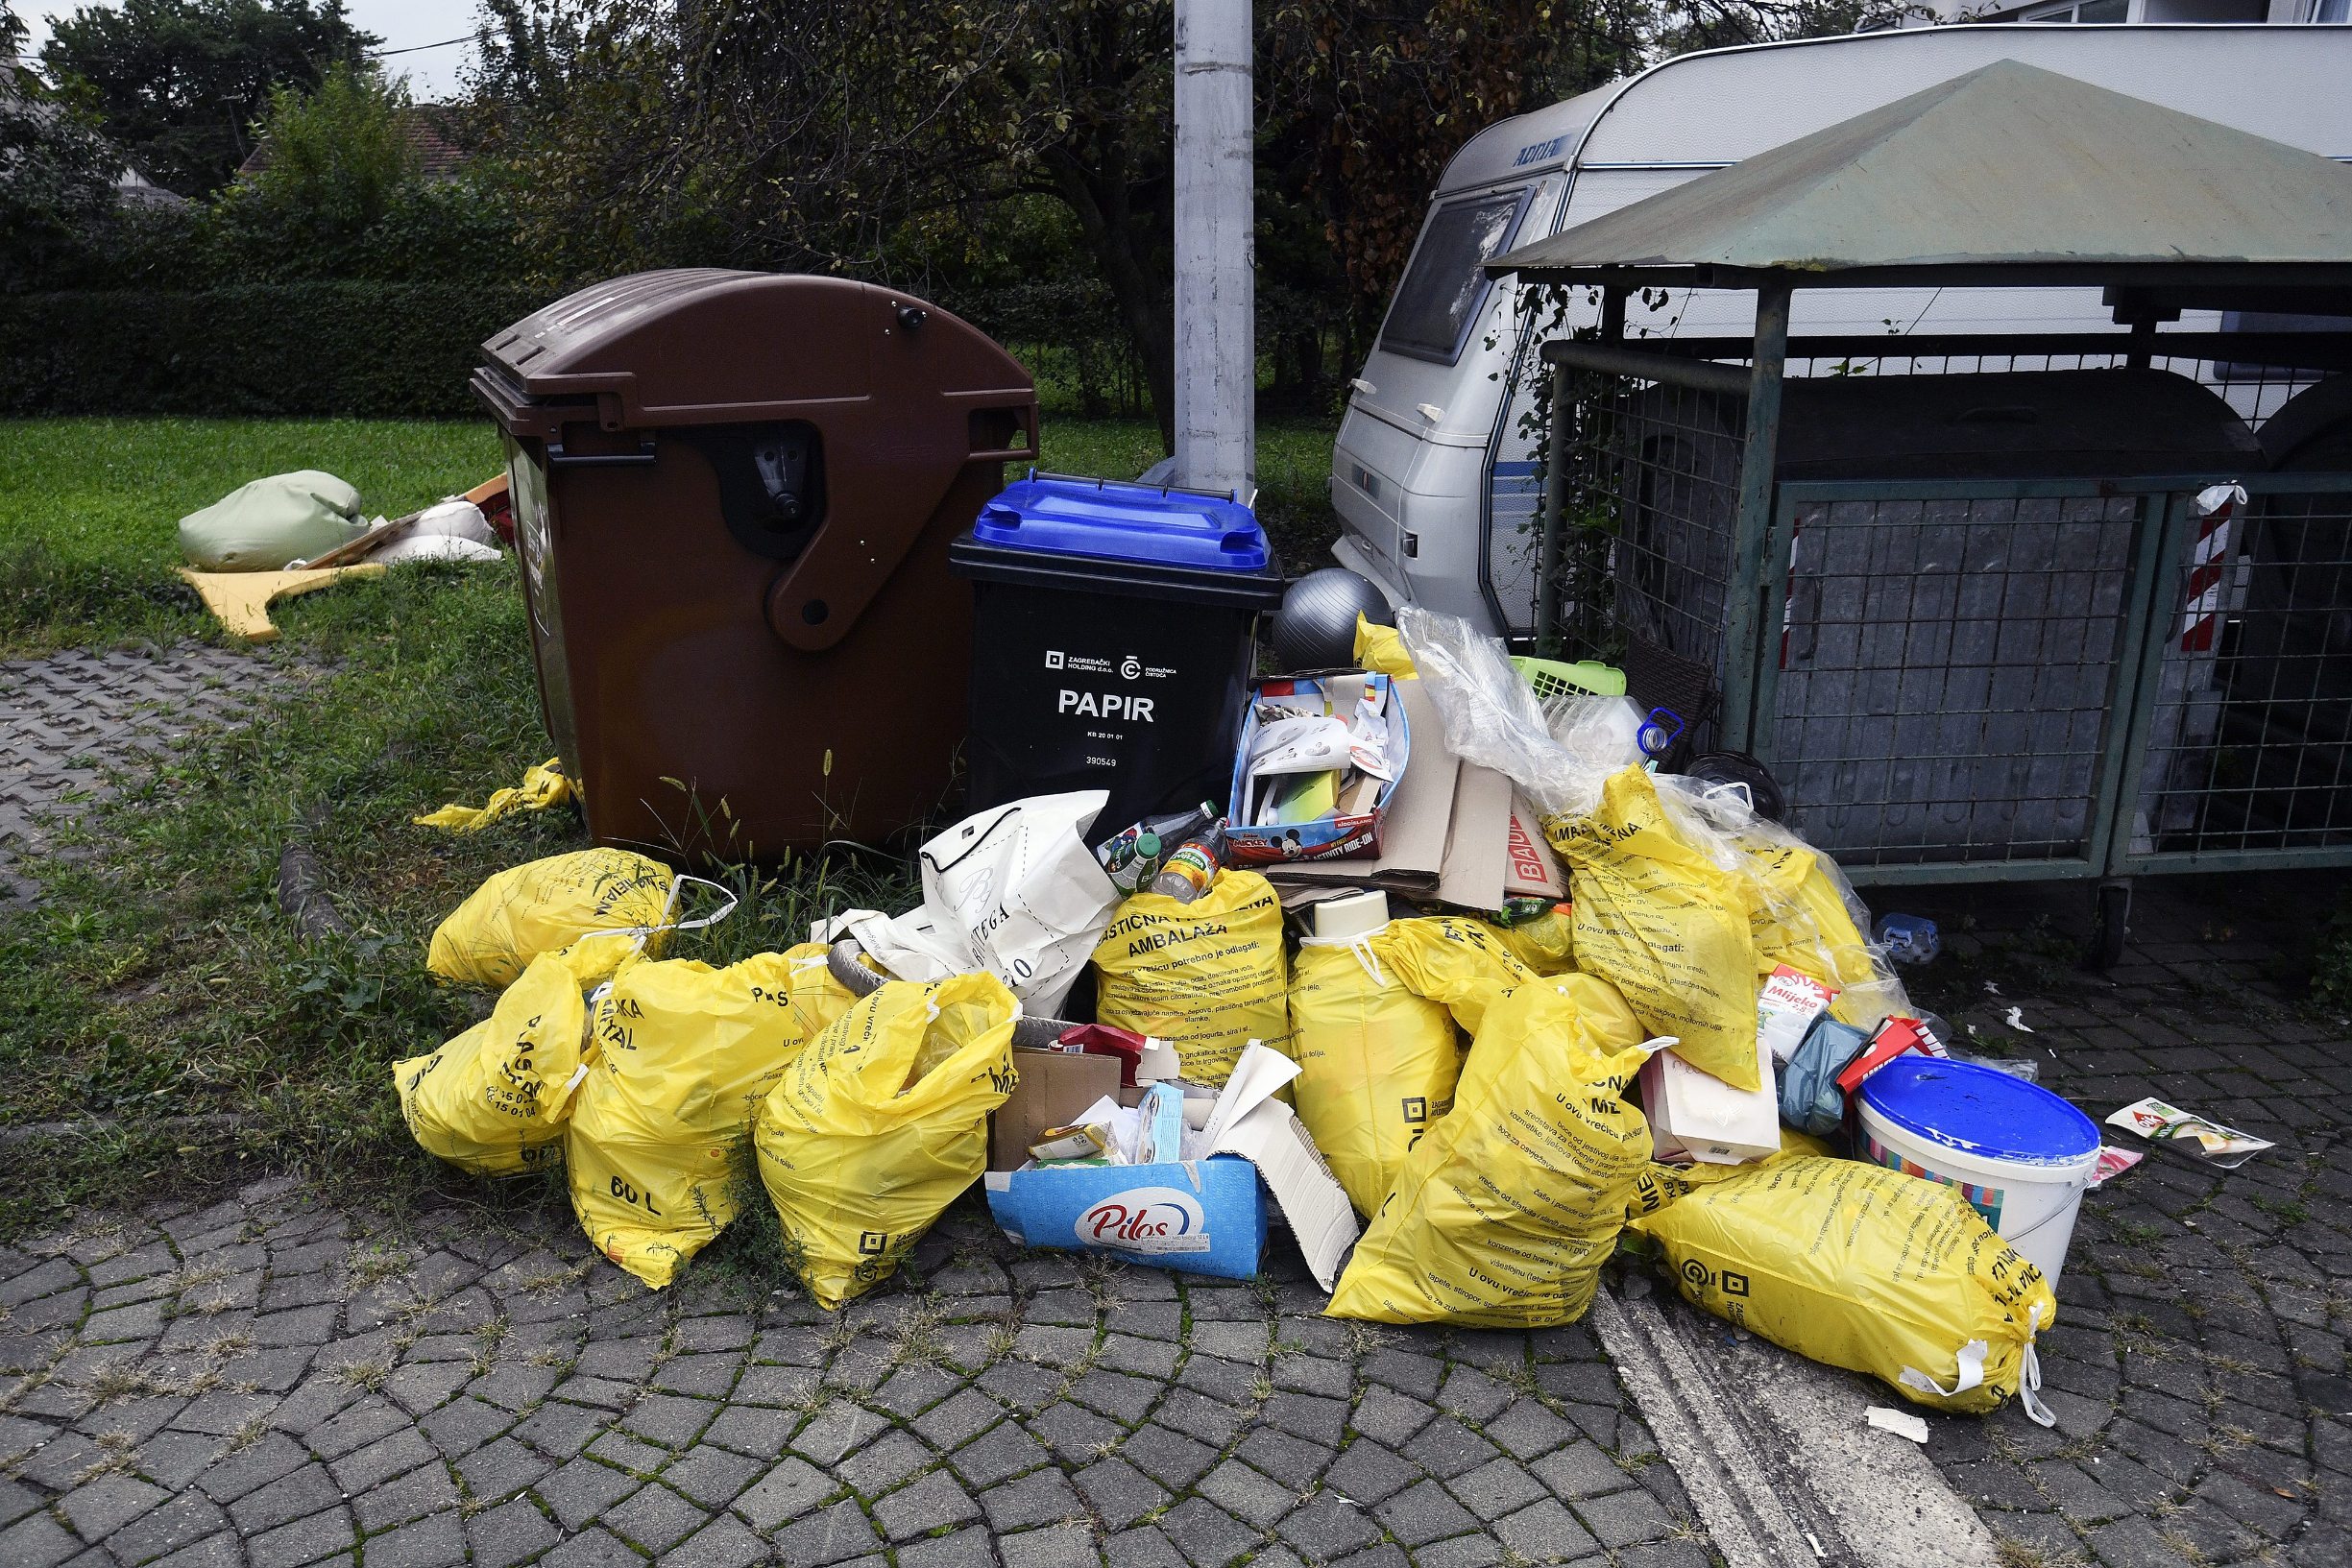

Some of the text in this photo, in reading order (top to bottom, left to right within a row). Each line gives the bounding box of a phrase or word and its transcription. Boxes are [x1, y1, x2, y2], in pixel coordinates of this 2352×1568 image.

[1513, 138, 1560, 167] ADRIA
[1068, 657, 1110, 666] ZAGREBAČKI
[1068, 663, 1096, 671] HOLDING
[1058, 689, 1153, 722] PAPIR
[1086, 757, 1116, 767] 390549
[1345, 833, 1373, 852] RIDE-ON
[1128, 923, 1227, 957] AMBALAŽA
[1587, 926, 1604, 934] ovu
[1606, 928, 1636, 940] vrećicu
[1172, 952, 1214, 970] potrebno
[1216, 950, 1224, 959] je
[1225, 941, 1260, 955] odlagati:
[870, 997, 880, 1013] ovu
[1767, 985, 1818, 1009] Mlijeko
[1184, 1014, 1210, 1024] slamke,
[1556, 1093, 1566, 1103] U
[1565, 1102, 1583, 1120] ovu
[1586, 1116, 1619, 1139] vrećicu
[1497, 1124, 1512, 1142] boce
[1511, 1136, 1519, 1146] za
[1509, 1109, 1590, 1174] kozmetike, lijekova (osim
[1524, 1109, 1558, 1136] sredstava
[1558, 1134, 1567, 1144] za
[1567, 1141, 1594, 1164] čišćenje
[1557, 1121, 1572, 1137] boce
[1573, 1136, 1583, 1145] od
[1583, 1140, 1609, 1160] jestivog
[611, 1175, 661, 1216] 60 L
[1478, 1174, 1500, 1195] vrećice
[1500, 1194, 1511, 1202] od
[1511, 1199, 1537, 1218] slatkiša
[1540, 1215, 1559, 1228] slanih
[1533, 1189, 1551, 1203] čaše
[1554, 1202, 1577, 1215] posude
[1088, 1205, 1169, 1241] Pilos
[1475, 1207, 1485, 1217] za
[1487, 1239, 1520, 1257] konzerve
[1521, 1250, 1532, 1259] od
[1533, 1253, 1554, 1266] hrane
[1468, 1266, 1478, 1278] U
[1479, 1274, 1499, 1290] ovu
[1491, 1259, 1526, 1277] višeslojnu
[1427, 1271, 1482, 1306] tapete, stiropor,
[1434, 1297, 1443, 1307] za
